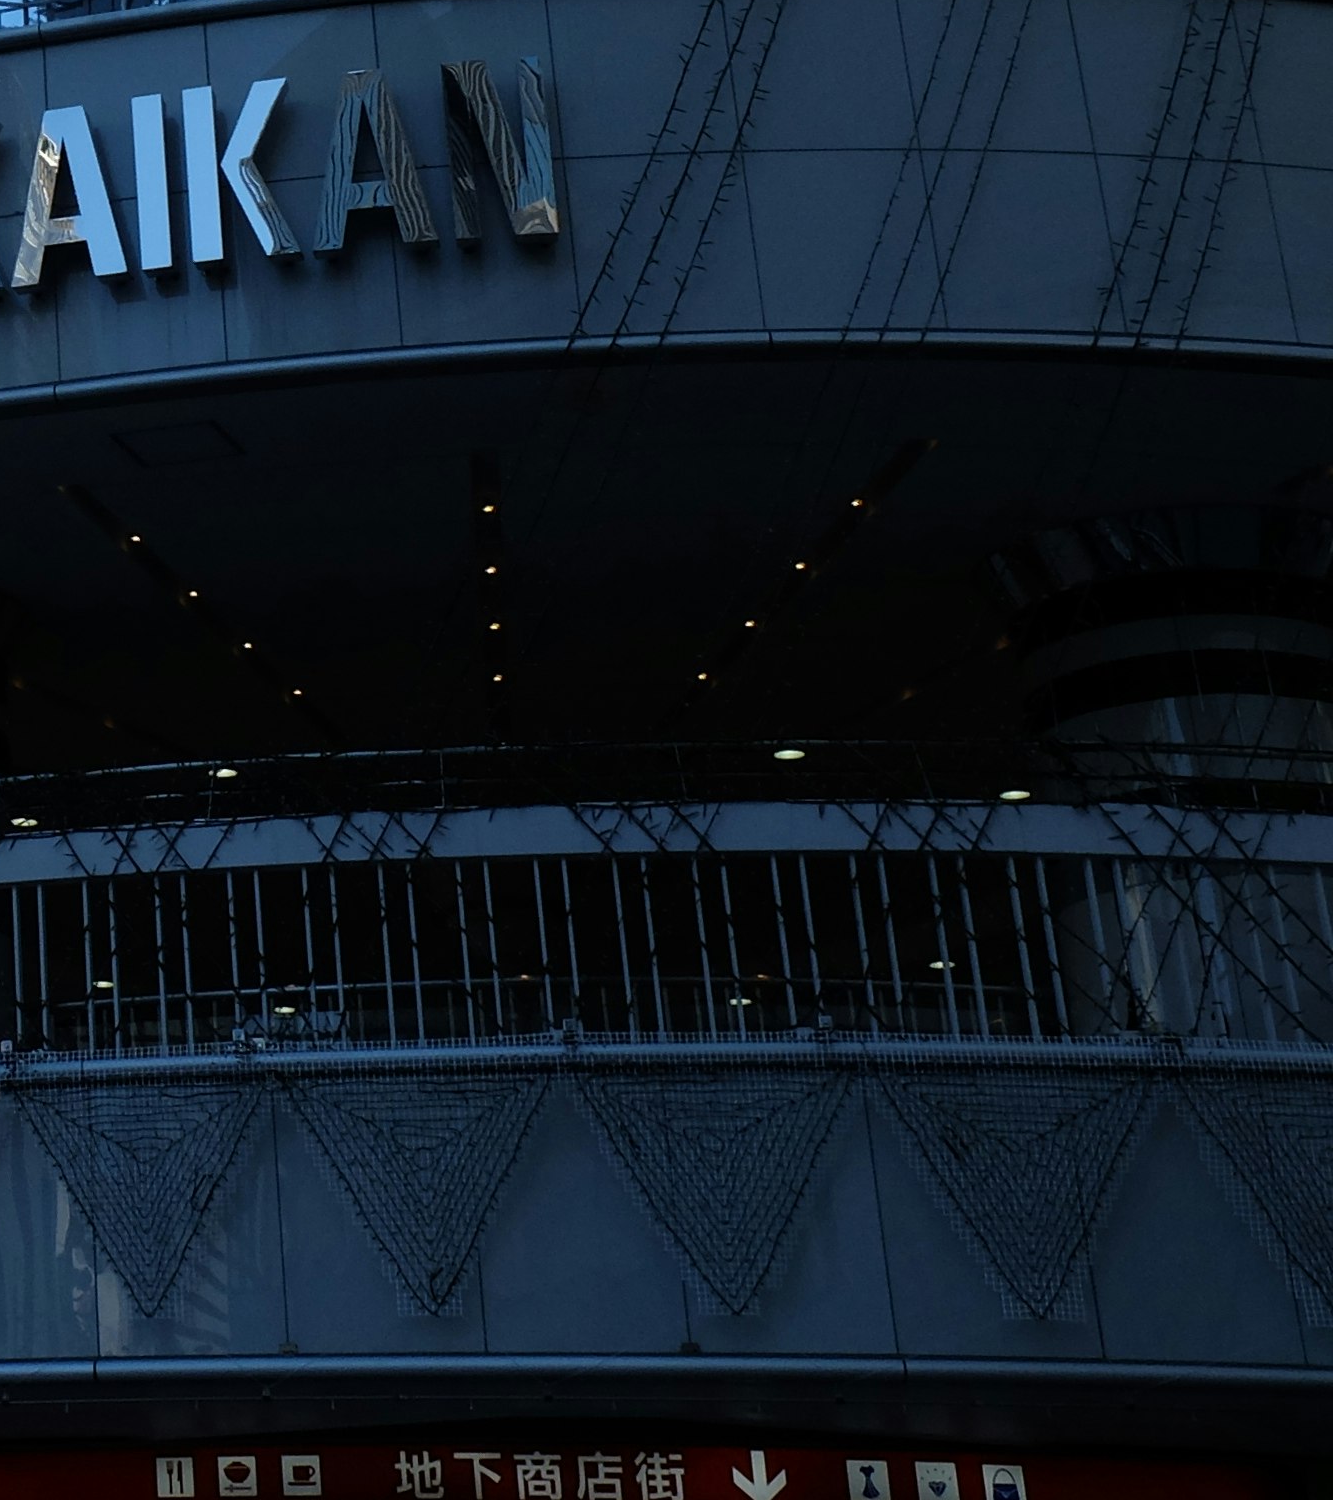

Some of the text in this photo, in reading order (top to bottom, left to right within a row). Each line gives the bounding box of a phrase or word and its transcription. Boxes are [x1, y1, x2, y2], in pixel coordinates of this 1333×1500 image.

[394, 1450, 685, 1500] 地下商店街
